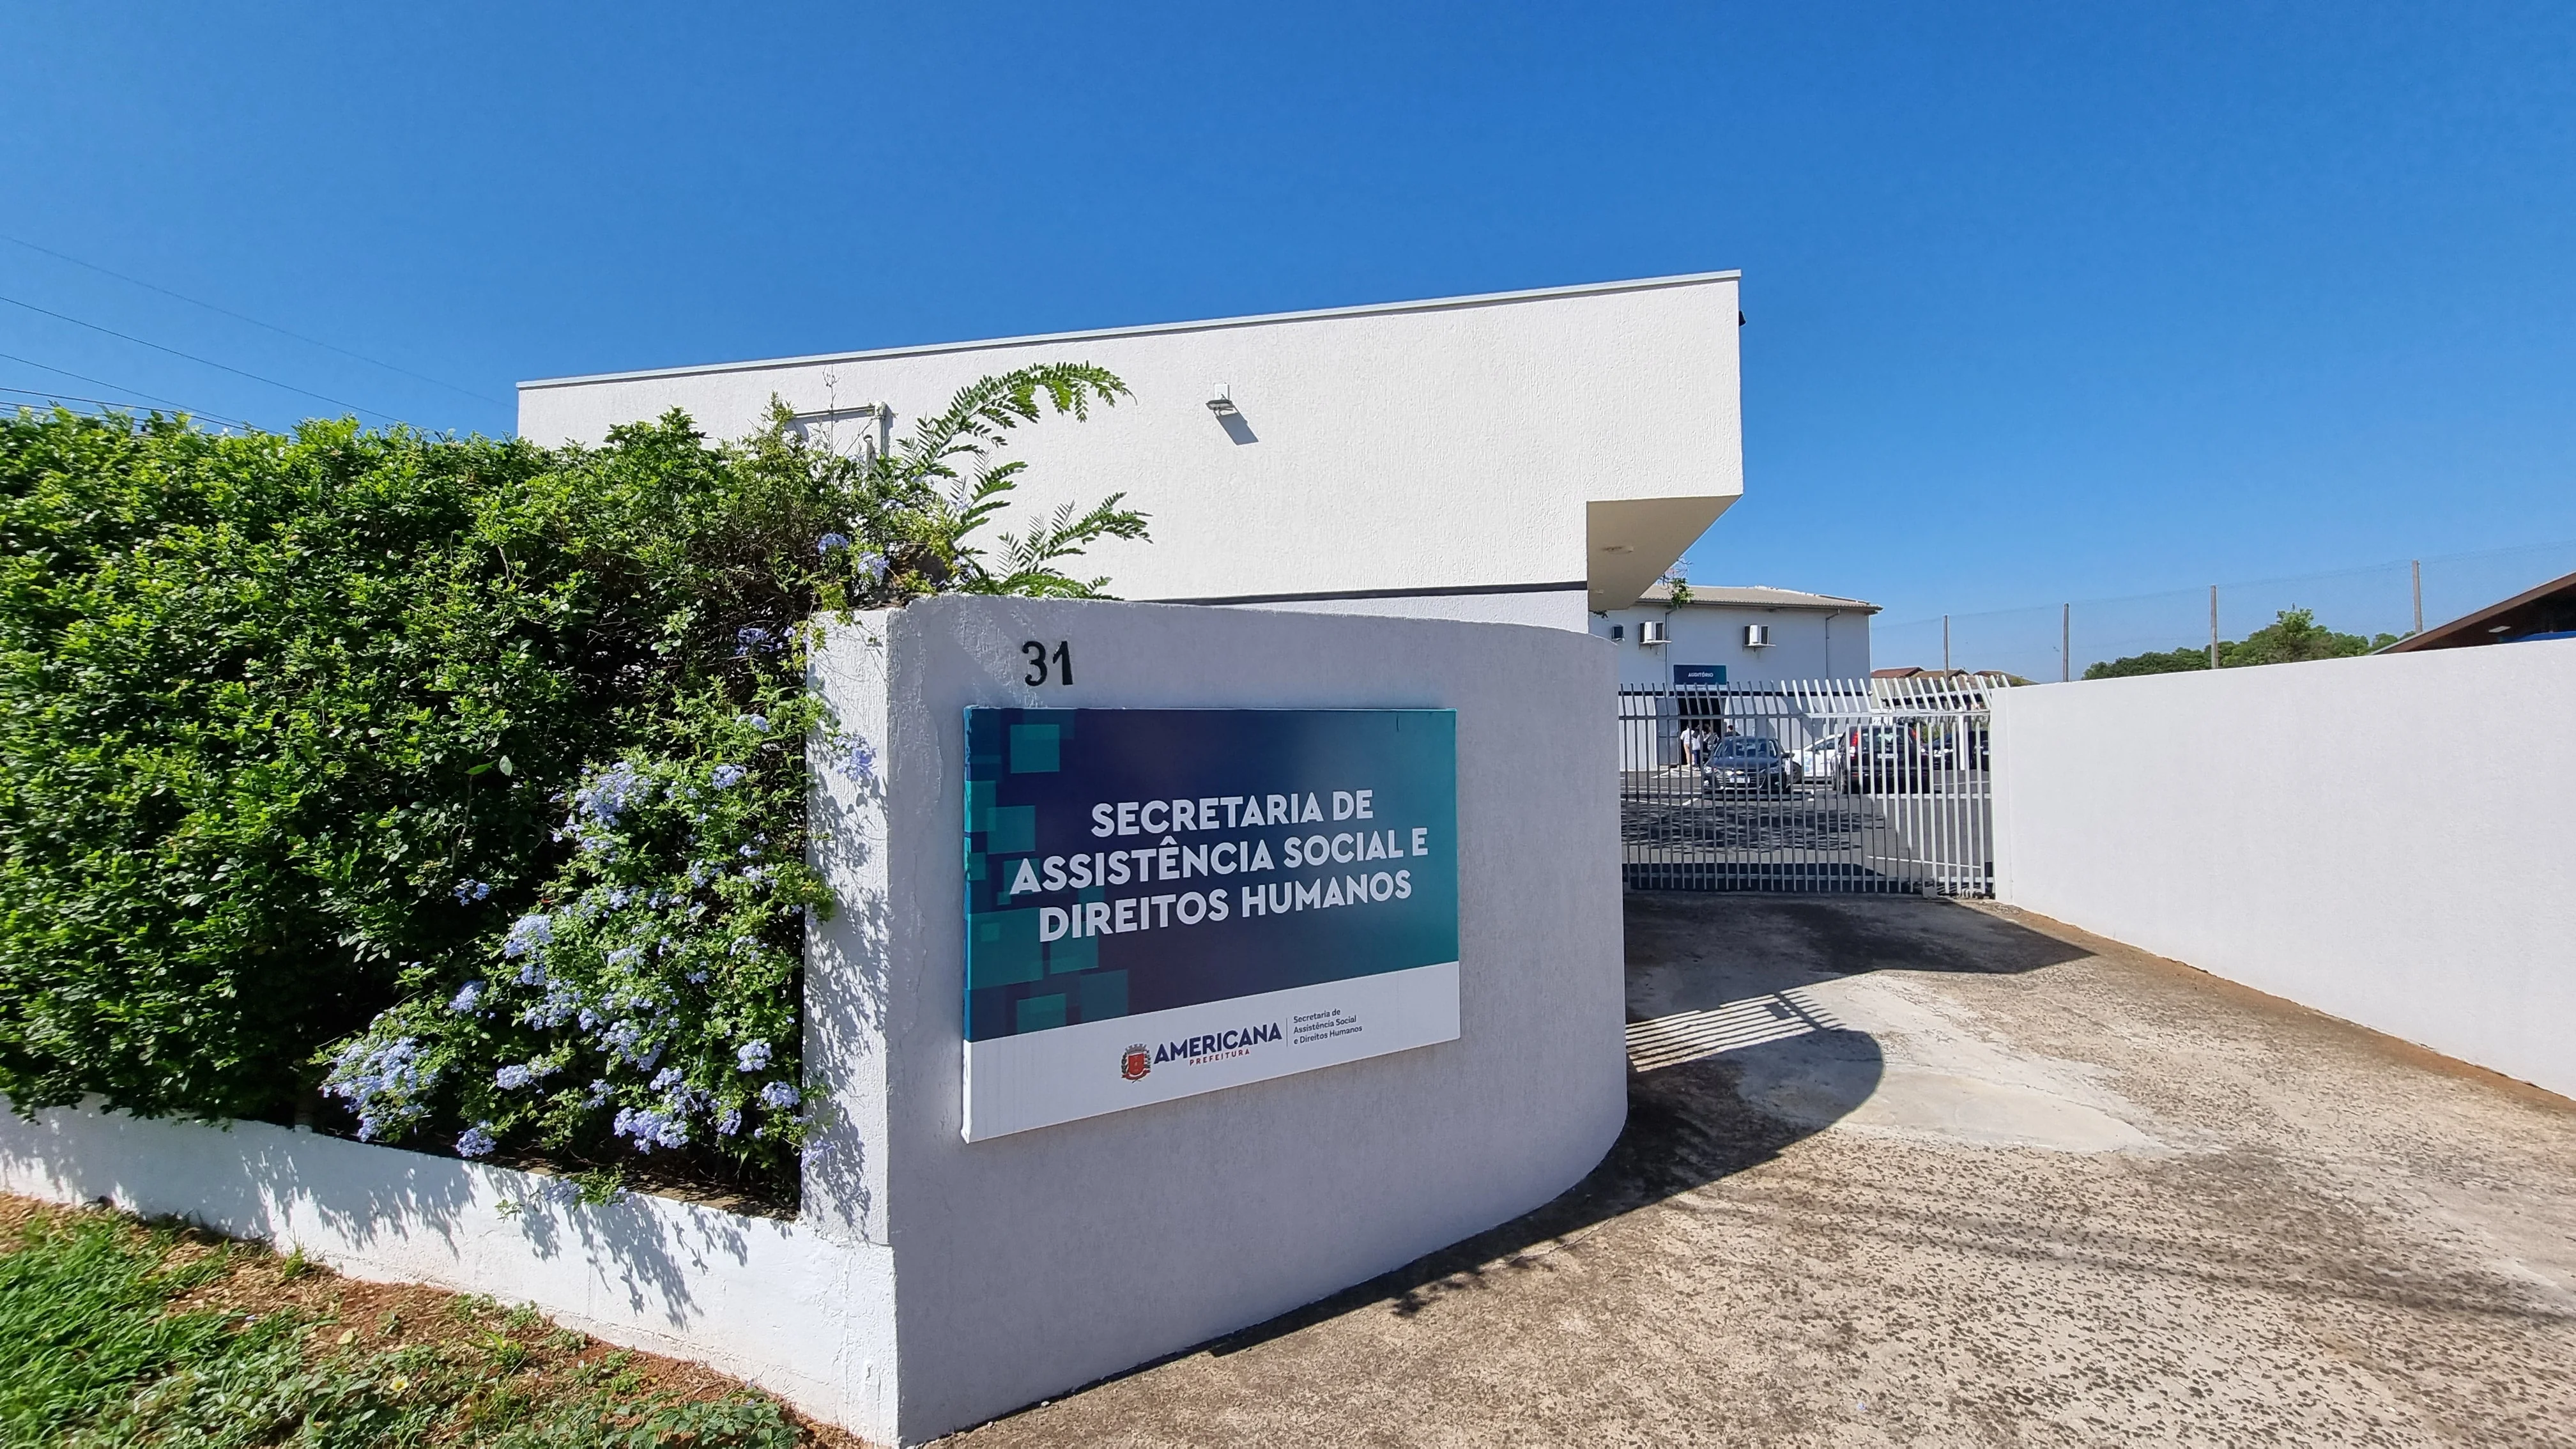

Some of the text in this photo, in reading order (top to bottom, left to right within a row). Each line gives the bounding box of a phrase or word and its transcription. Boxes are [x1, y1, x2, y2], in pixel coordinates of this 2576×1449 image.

[1022, 641, 1073, 686] 31
[1091, 790, 1374, 838] SECRETARIA DE
[1009, 827, 1428, 894] ASSISTÊNCIA SOCIAL E
[1039, 870, 1412, 942] DIREITOS HUMANOS
[1293, 1010, 1330, 1023] Secretaria
[1294, 1015, 1357, 1034] Assistência Social
[1300, 1033, 1328, 1044] Direitos
[1330, 1025, 1363, 1038] Humanos
[1154, 1022, 1282, 1064] AMERICANA
[1190, 1048, 1250, 1066] PREFEITURA
